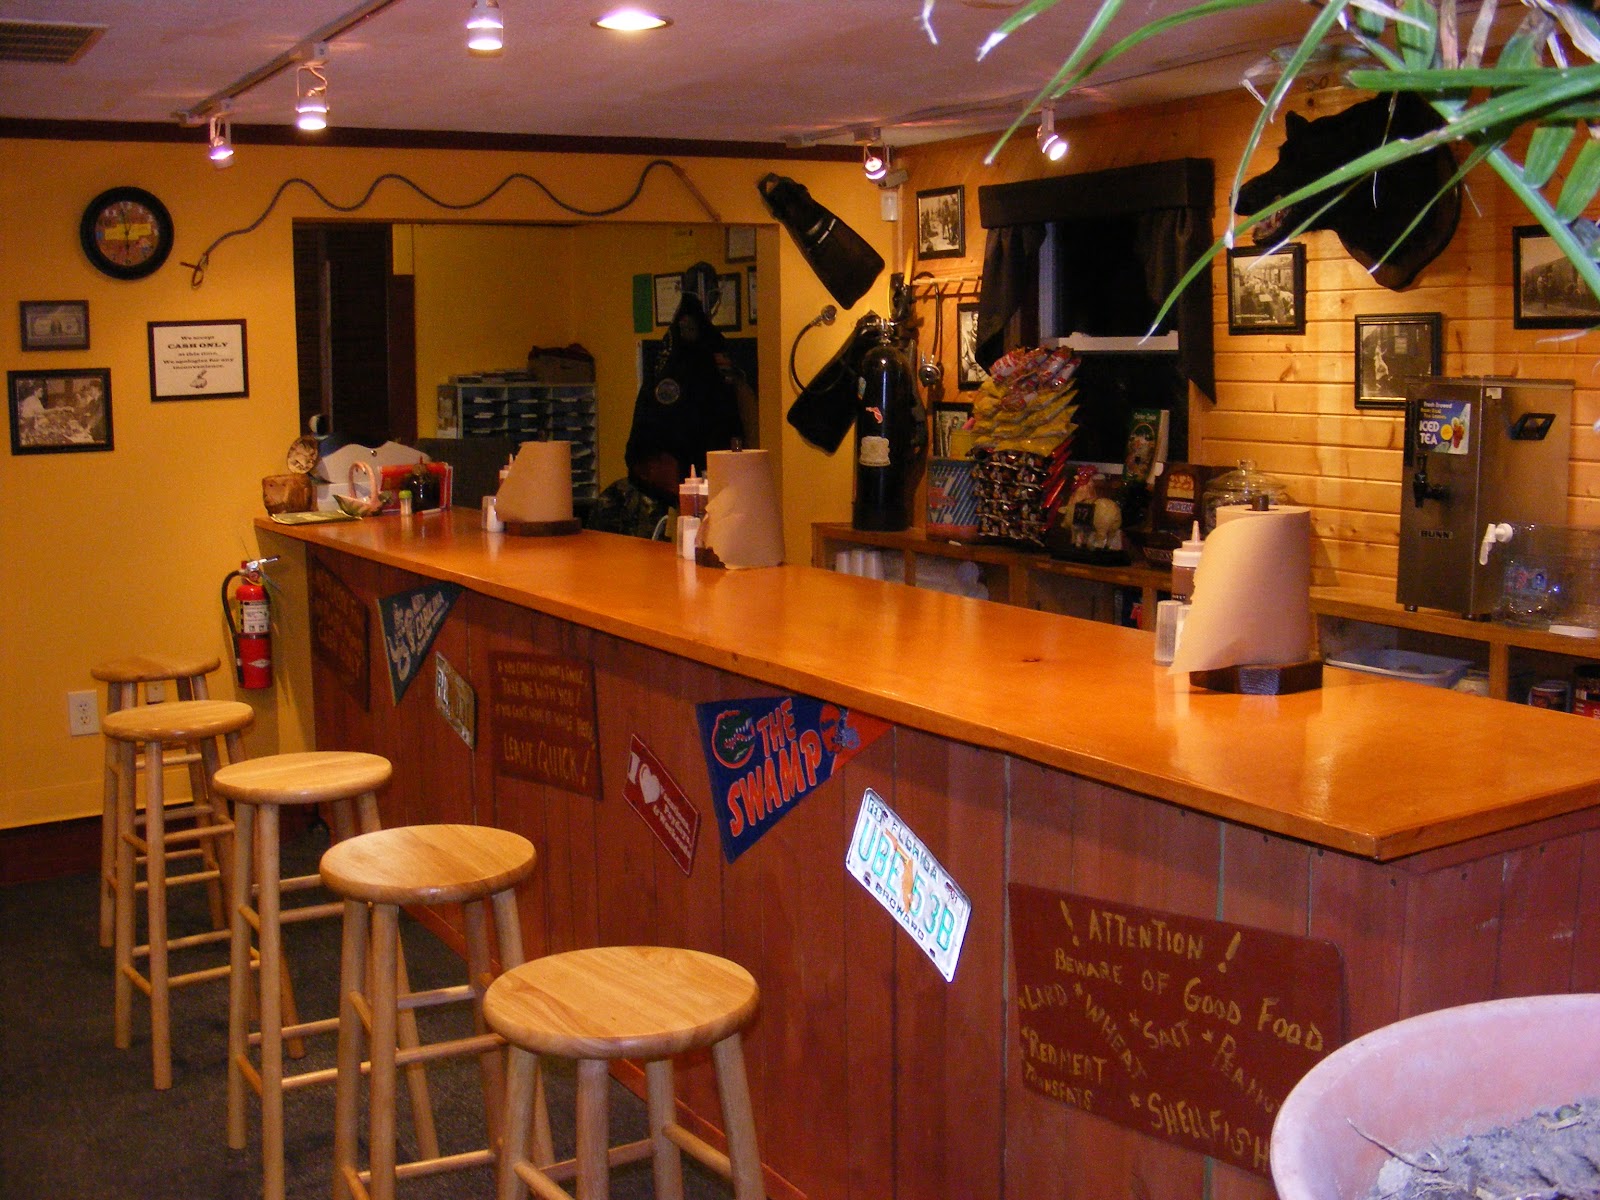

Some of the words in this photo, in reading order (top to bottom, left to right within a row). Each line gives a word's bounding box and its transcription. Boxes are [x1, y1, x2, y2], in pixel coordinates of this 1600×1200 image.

[167, 342, 197, 350] CASH
[1419, 420, 1440, 432] ICED
[1420, 432, 1438, 445] TEA
[1421, 530, 1450, 539] BUNN
[757, 698, 797, 758] THE
[503, 733, 534, 768] LEAVE
[537, 739, 579, 783] QUICK
[628, 751, 641, 785] I
[727, 729, 822, 837] SWAMP
[867, 797, 883, 824] FEB
[858, 818, 903, 897] UBE
[892, 821, 940, 883] FLORIDA
[874, 882, 925, 941] BROWARD
[1088, 909, 1204, 961] ATTENTION
[1055, 947, 1123, 986] BEWARE
[1141, 969, 1170, 995] OF
[1184, 977, 1242, 1025] GOOD
[1257, 997, 1324, 1051] FOOD
[1085, 994, 1148, 1080] WHEAT
[1143, 1018, 1190, 1049] SALT
[1148, 1092, 1270, 1172] SHELLFISH
